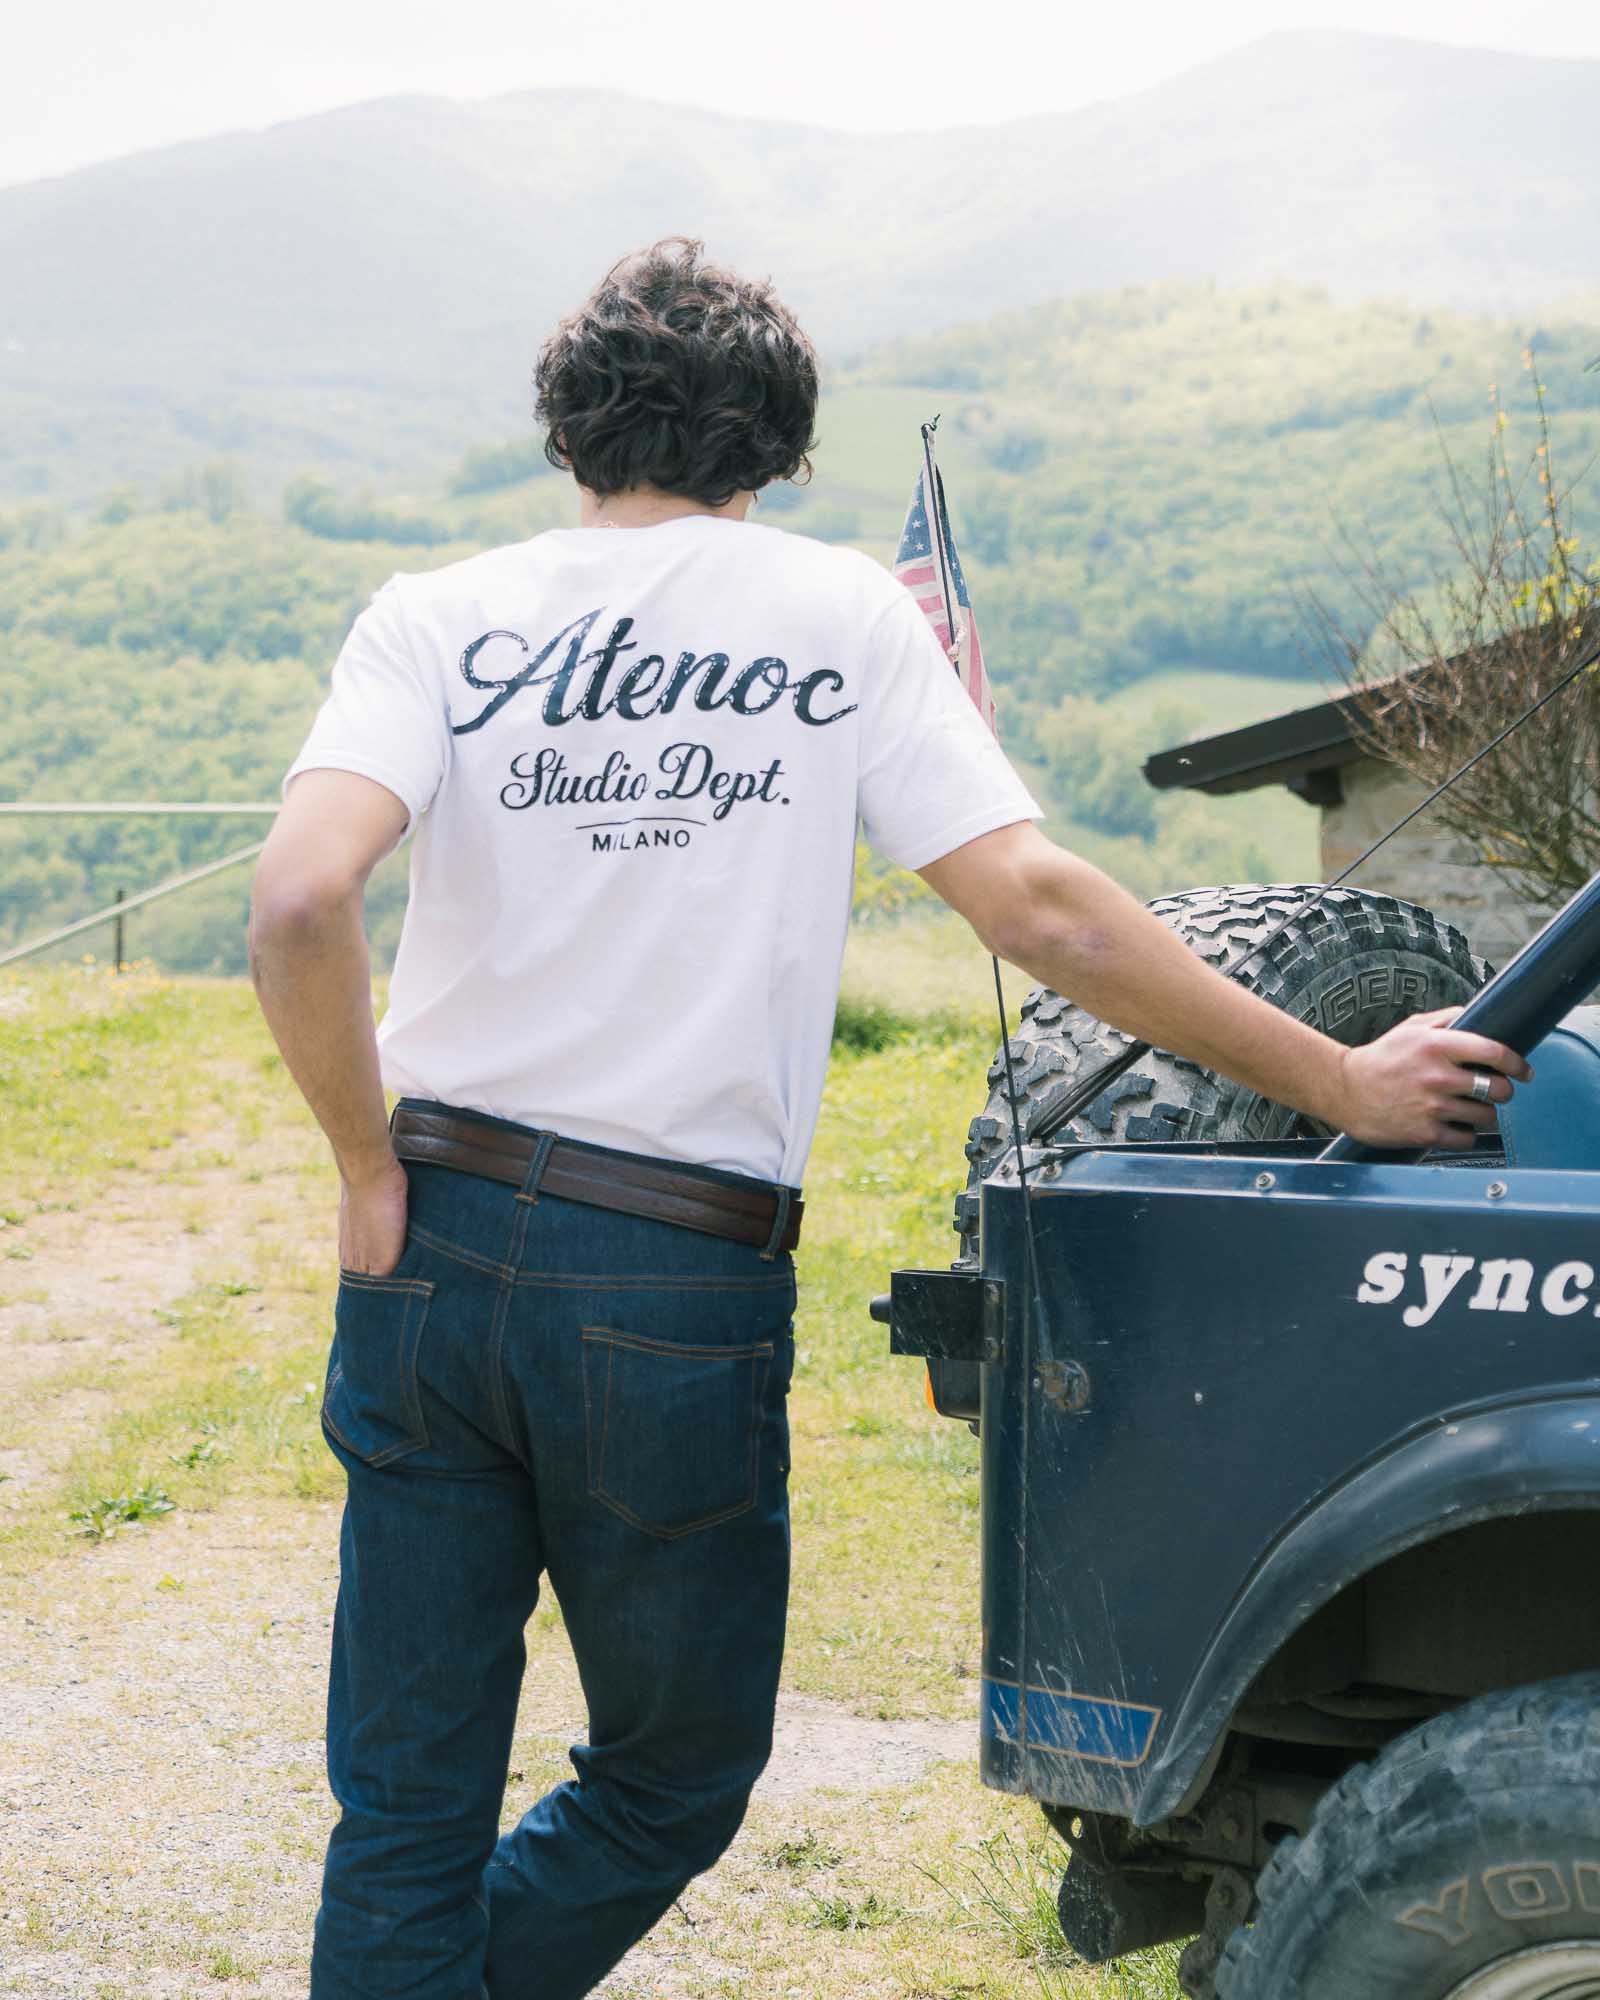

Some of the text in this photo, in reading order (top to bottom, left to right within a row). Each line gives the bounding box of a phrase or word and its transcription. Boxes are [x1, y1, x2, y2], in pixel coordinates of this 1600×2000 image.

[452, 606, 858, 735] Atenoc
[500, 742, 791, 820] Studio Dept.
[592, 829, 690, 852] MILANO
[1298, 967, 1429, 1031] GER
[1357, 1251, 1600, 1328] sync
